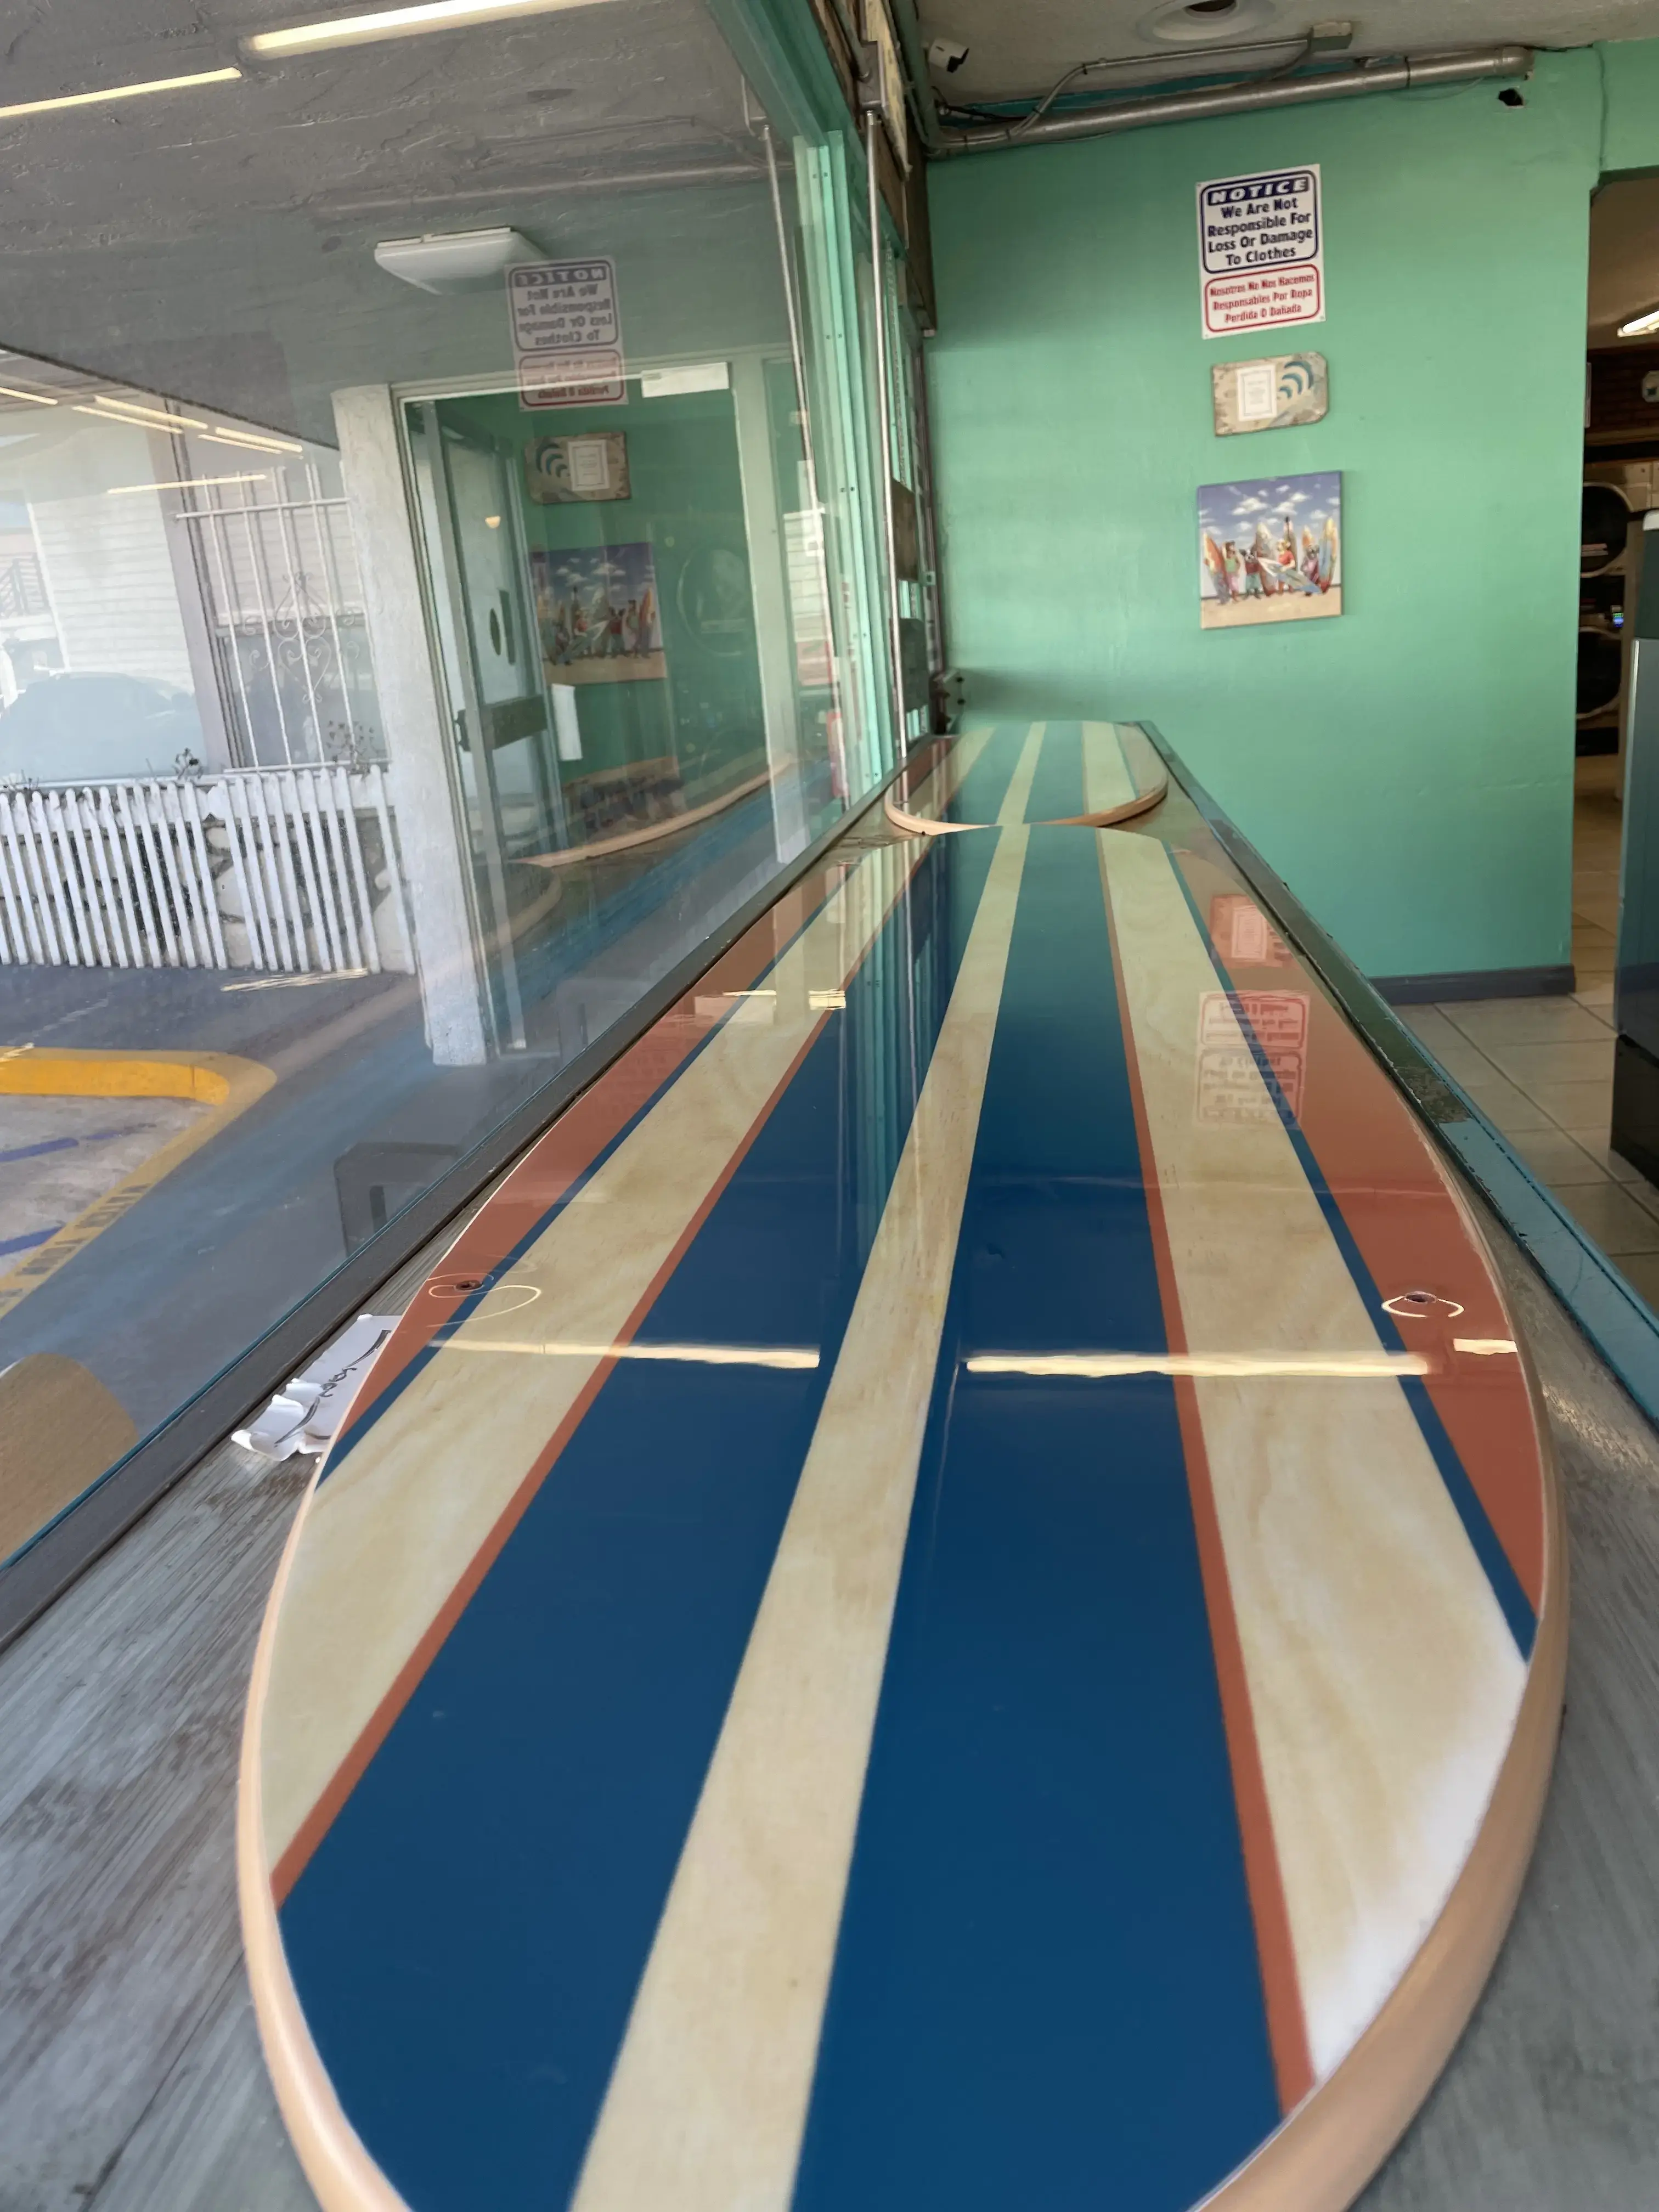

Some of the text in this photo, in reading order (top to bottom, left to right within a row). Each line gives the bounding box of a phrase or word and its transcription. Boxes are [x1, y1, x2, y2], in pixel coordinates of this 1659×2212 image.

[1211, 179, 1307, 203] NOTICE
[1221, 198, 1298, 218] We Are Not
[1208, 212, 1311, 236] Responsible For
[1208, 229, 1313, 253] Loss Or Damage
[1226, 247, 1296, 266] To Clothes
[1210, 285, 1246, 296] Nosotros
[1248, 282, 1259, 290] No
[1261, 279, 1276, 288] Nos
[1213, 295, 1271, 311] Responsables
[1272, 292, 1288, 302] Por
